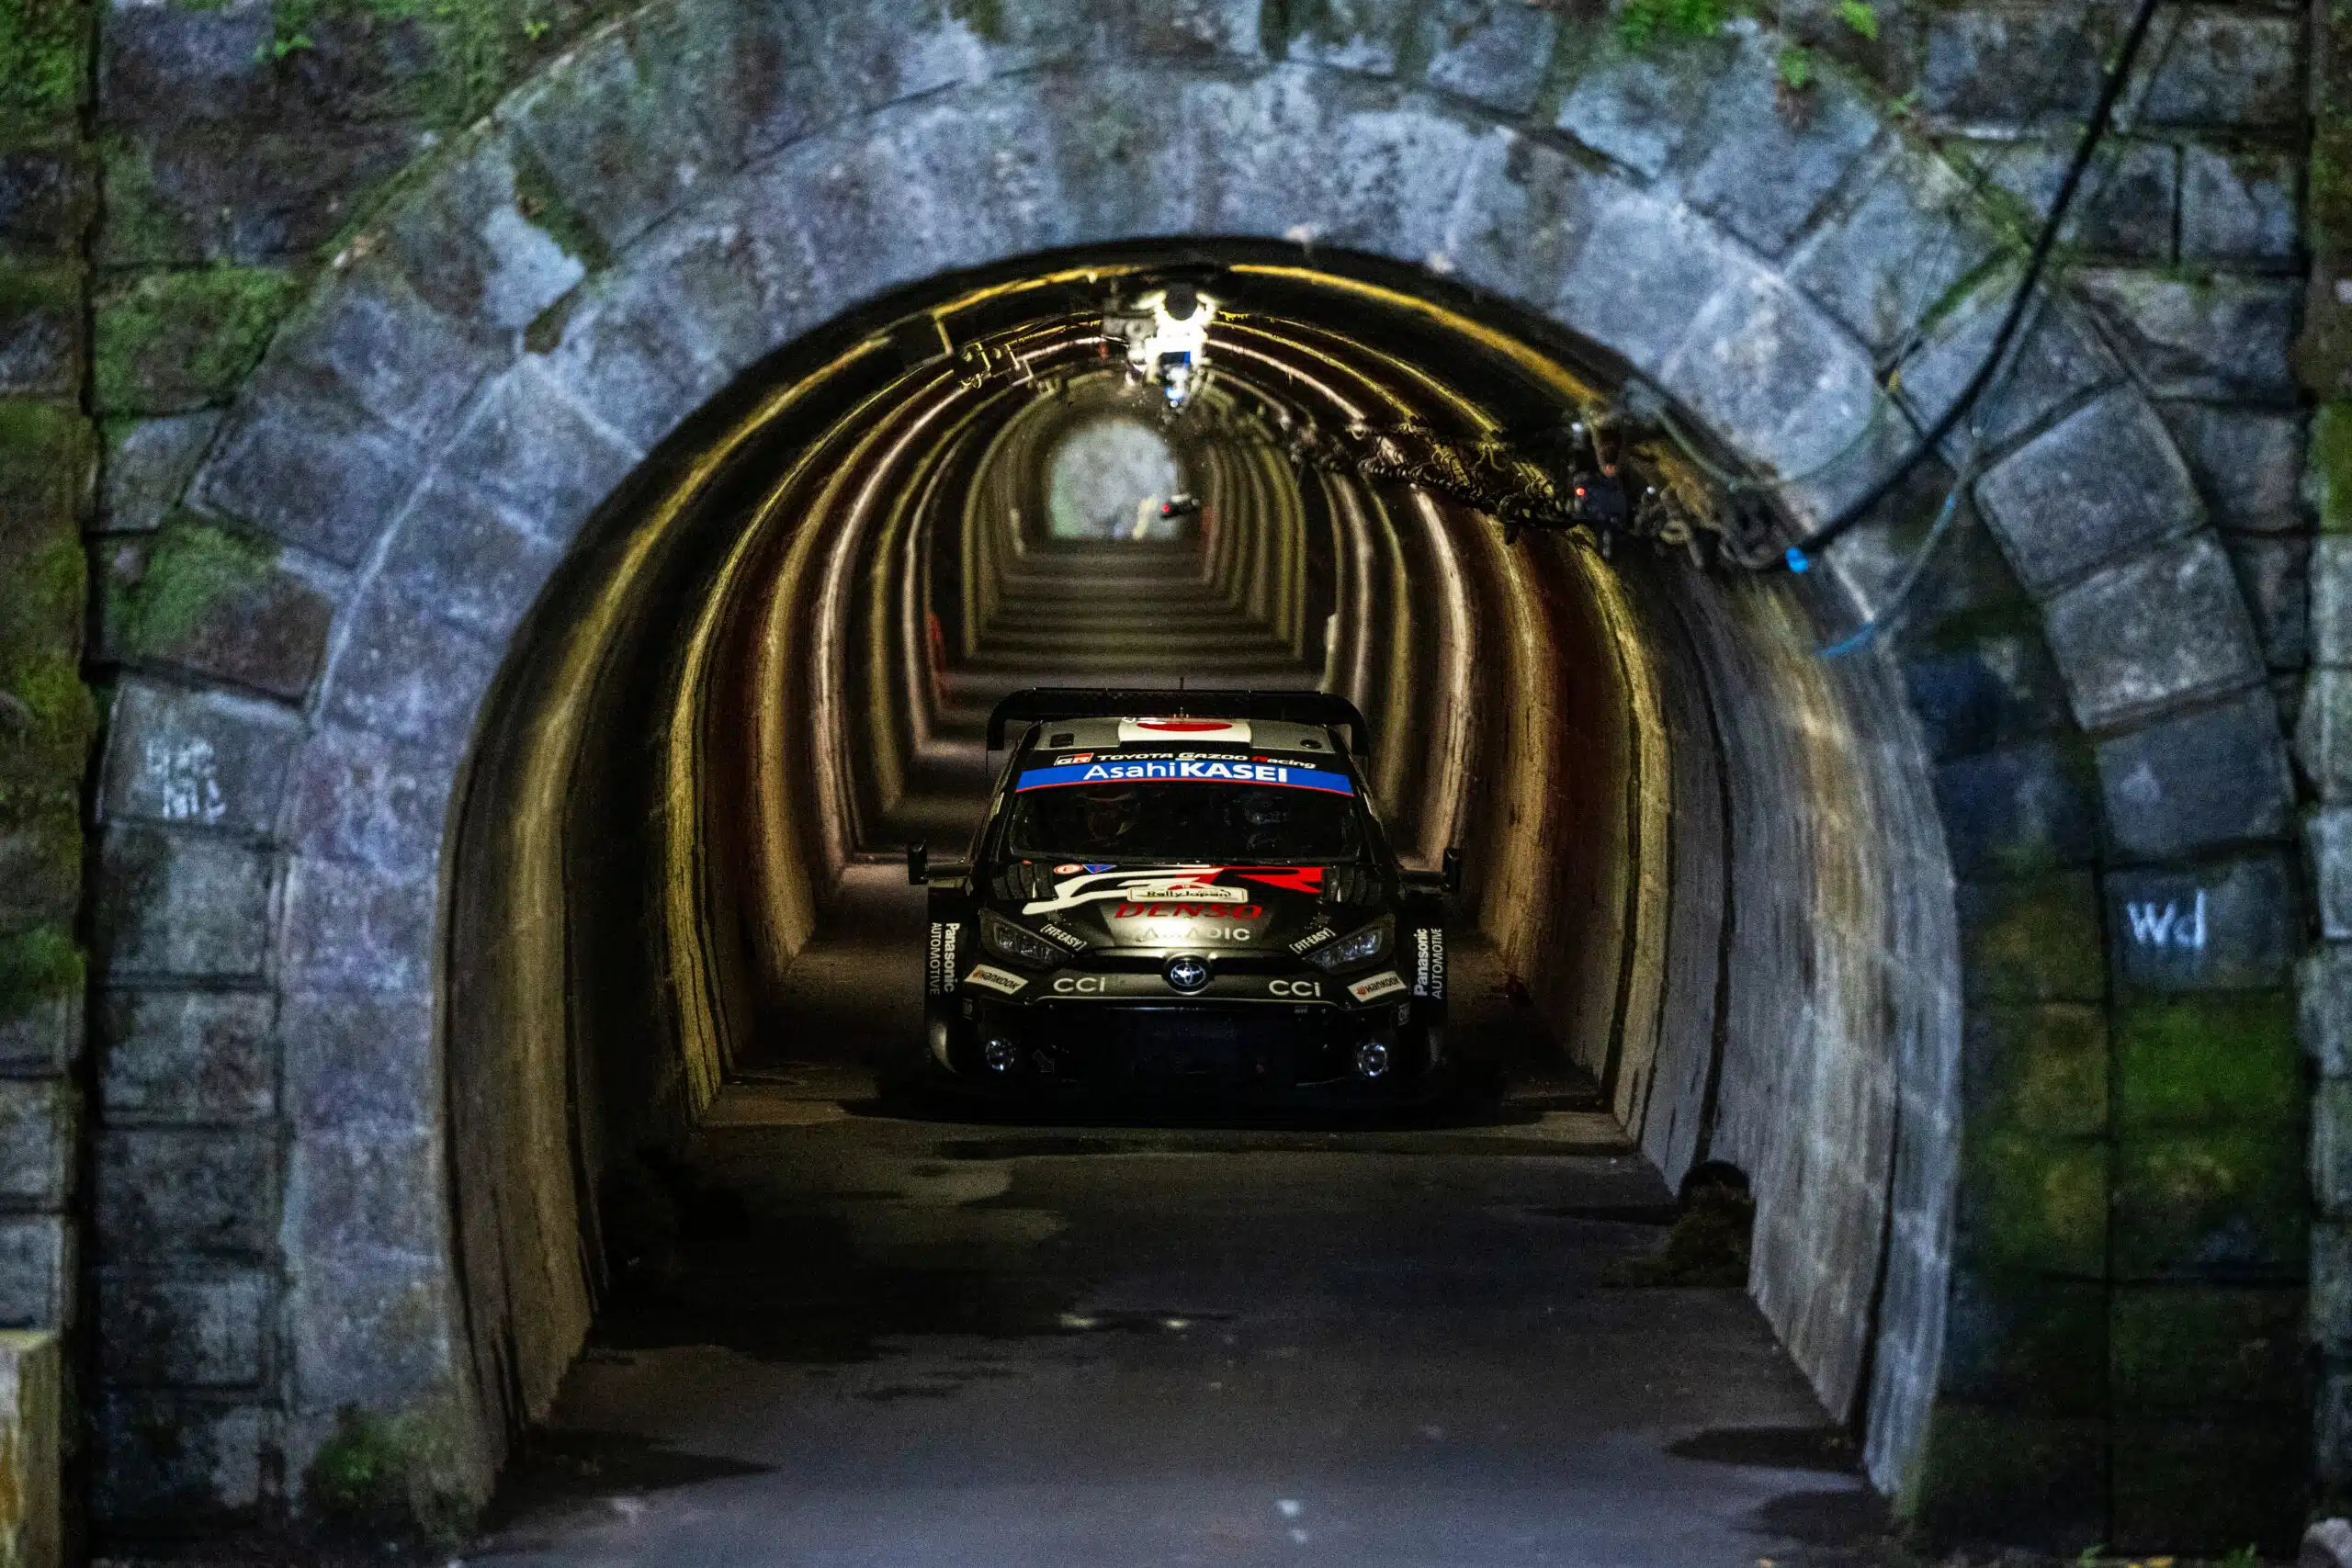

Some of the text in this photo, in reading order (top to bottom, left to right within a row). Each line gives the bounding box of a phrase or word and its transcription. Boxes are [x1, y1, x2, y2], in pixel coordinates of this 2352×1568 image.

[1056, 754, 1091, 765] GR
[1176, 752, 1249, 761] GAZOO
[1252, 756, 1317, 769] Racing
[1114, 903, 1262, 919] DENSO
[930, 922, 942, 996] AUTOMOTIVE
[944, 922, 960, 993] Panasonic
[1414, 928, 1429, 997] Panasonic
[1431, 928, 1443, 999] AUTOMOTIVE
[1053, 977, 1105, 992] CCI
[1269, 980, 1320, 998] CCI
